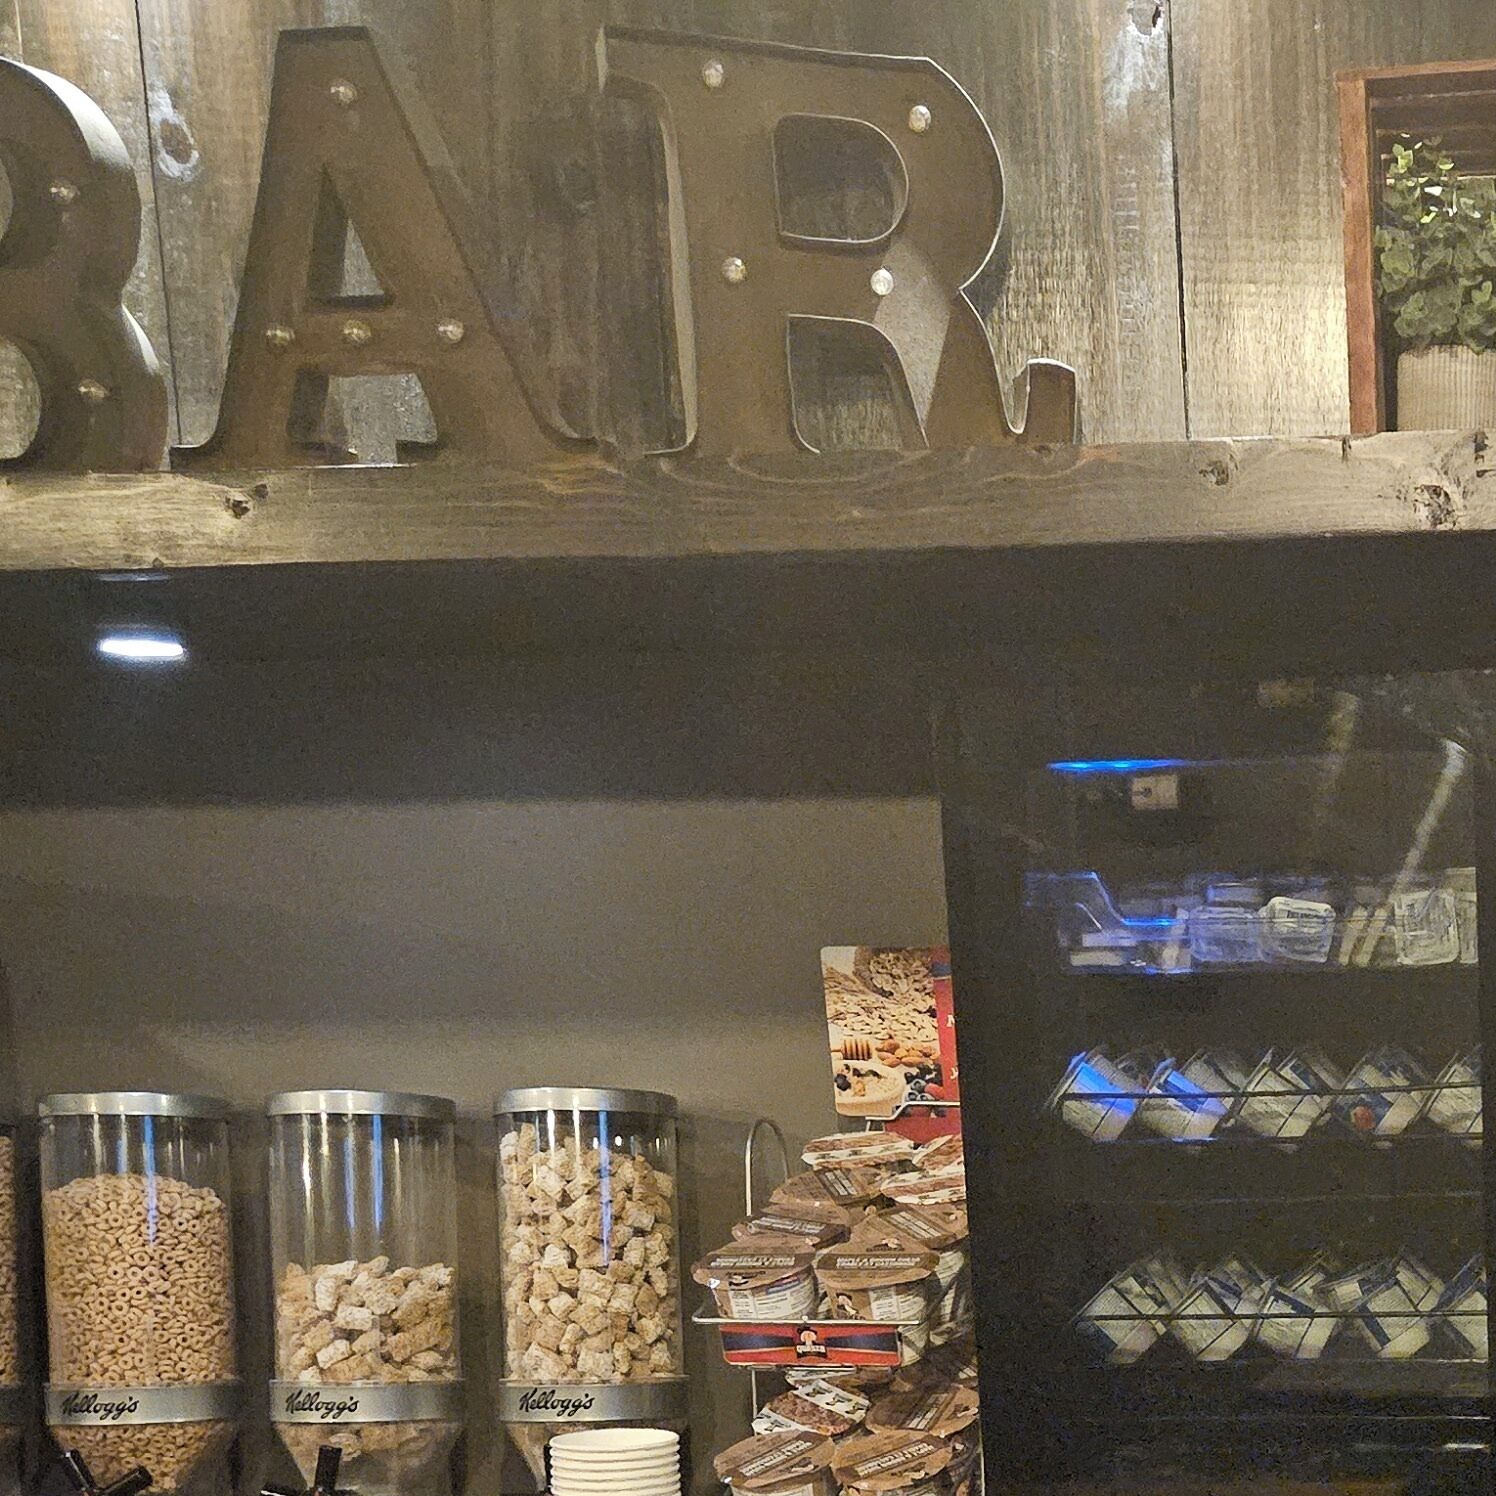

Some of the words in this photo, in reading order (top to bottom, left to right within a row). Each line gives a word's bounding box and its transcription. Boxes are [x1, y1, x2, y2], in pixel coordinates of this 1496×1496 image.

[62, 1390, 140, 1421] Kellogg's
[285, 1387, 360, 1420] Kellogg's
[518, 1387, 596, 1418] Kellogg's
